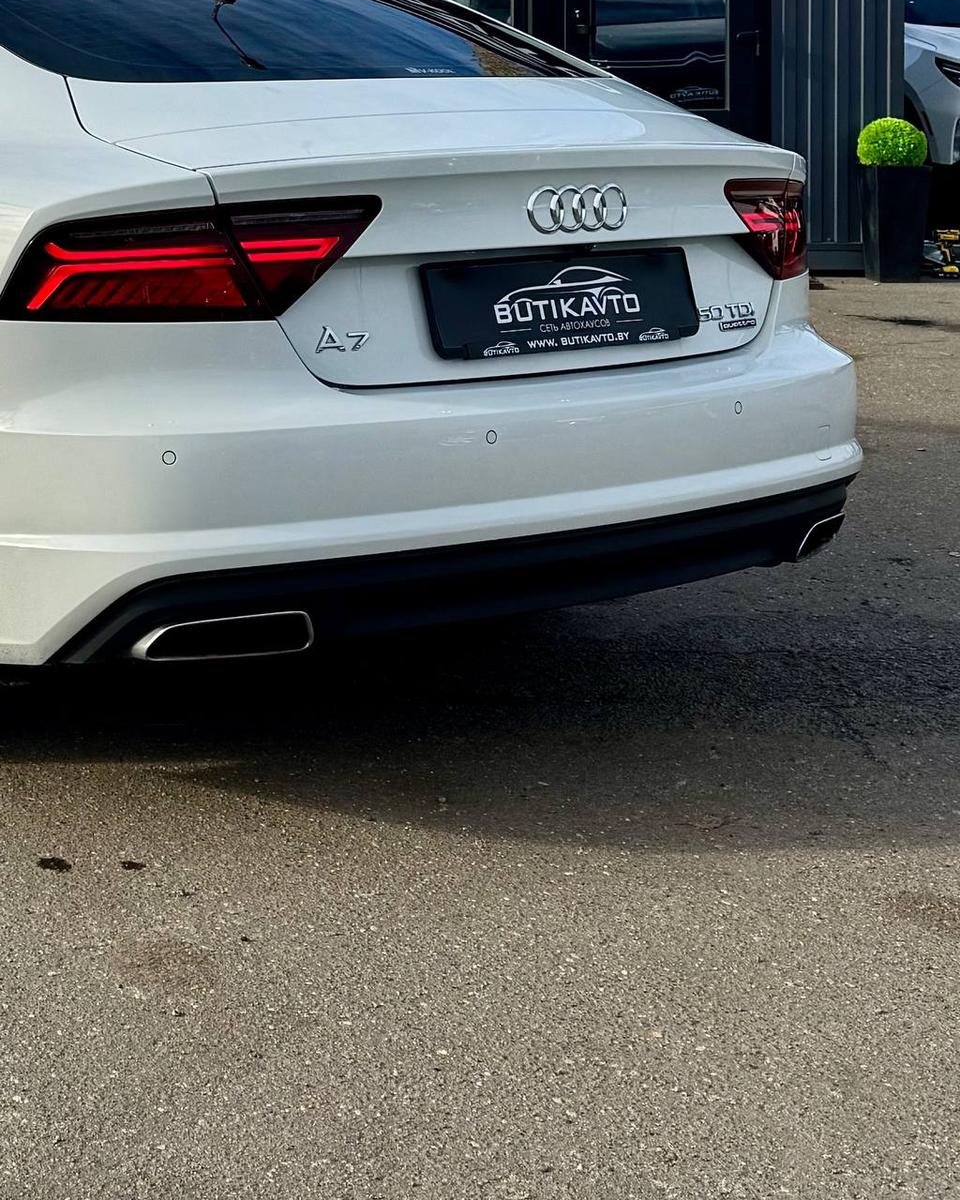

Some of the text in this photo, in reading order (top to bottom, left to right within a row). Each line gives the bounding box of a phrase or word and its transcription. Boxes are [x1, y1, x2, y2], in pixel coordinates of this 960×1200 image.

[493, 292, 641, 325] BUTIKAVTO
[697, 302, 755, 322] 50 TDI
[539, 318, 611, 333] СЕТЬ АВТОХАУСОВ
[722, 319, 757, 331] quattro
[315, 325, 370, 354] A7
[526, 331, 630, 349] WWW. BUTIKAVTO.BY
